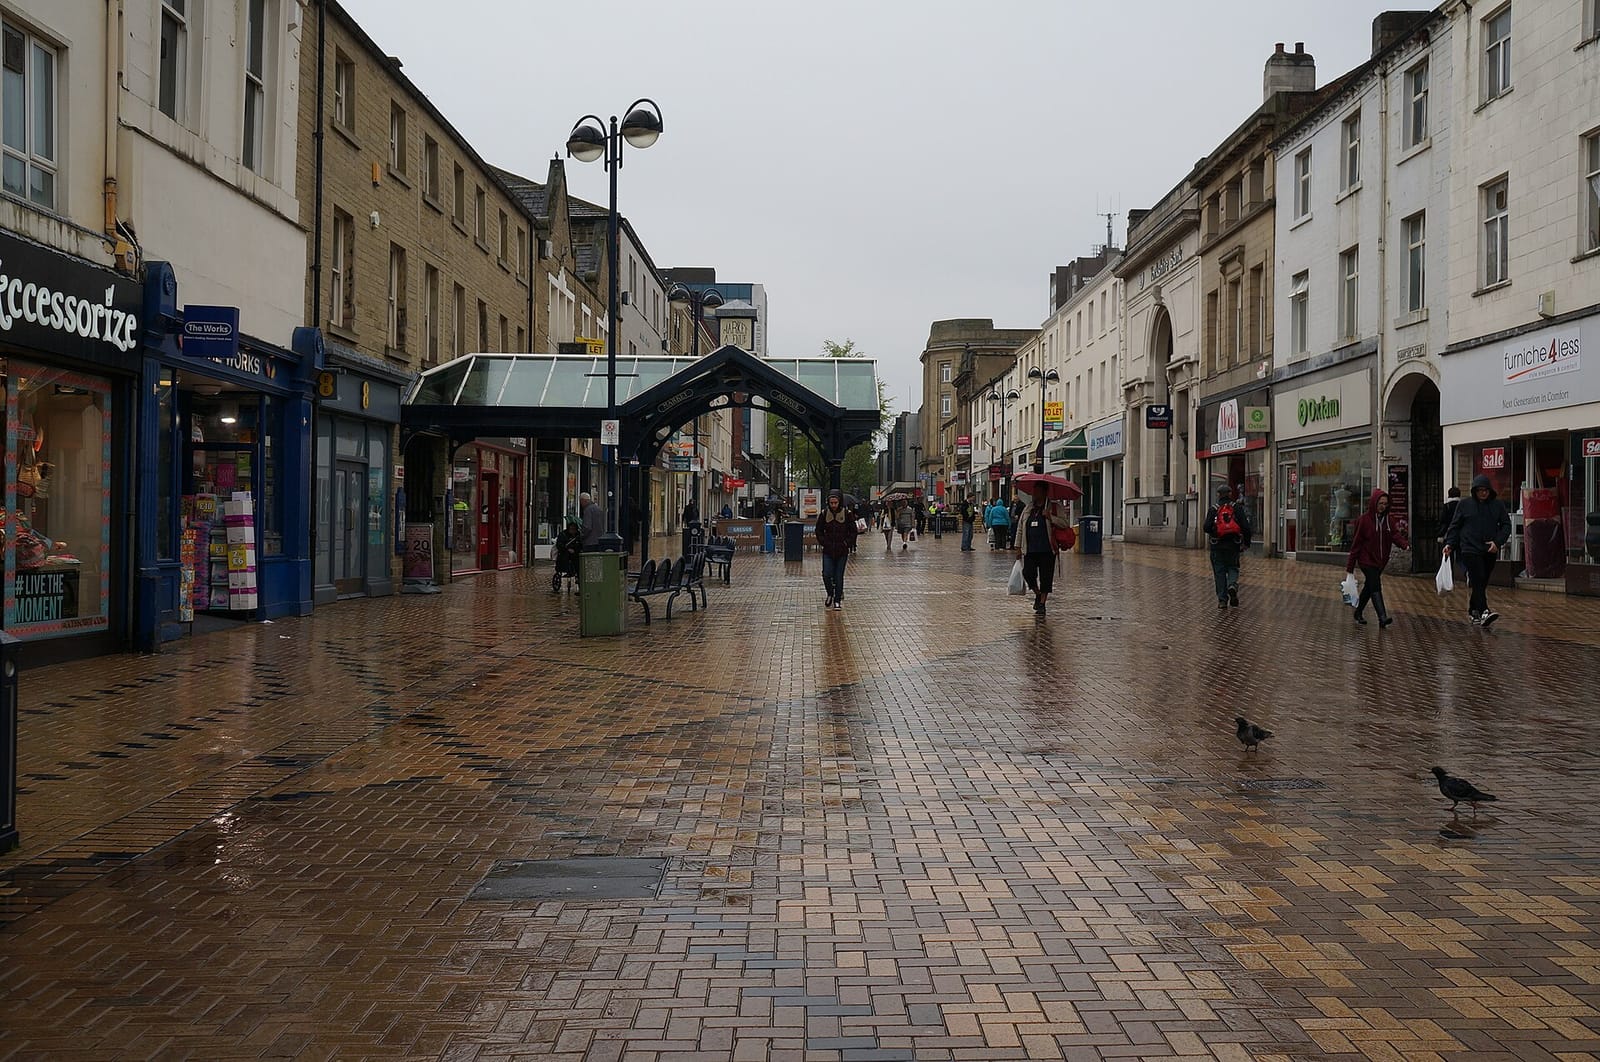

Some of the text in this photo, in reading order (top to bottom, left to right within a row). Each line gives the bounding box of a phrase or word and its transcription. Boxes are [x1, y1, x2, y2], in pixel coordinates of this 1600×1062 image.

[189, 324, 229, 333] The Works
[589, 346, 603, 354] LET
[1504, 338, 1580, 371] furniche4less
[1514, 394, 1541, 407] Generation
[1547, 390, 1569, 402] Comfort
[1052, 407, 1063, 416] LET
[1307, 395, 1340, 422] Oxfam
[1483, 450, 1503, 467] sale
[48, 573, 64, 594] THE
[15, 595, 64, 623] MOMENT
